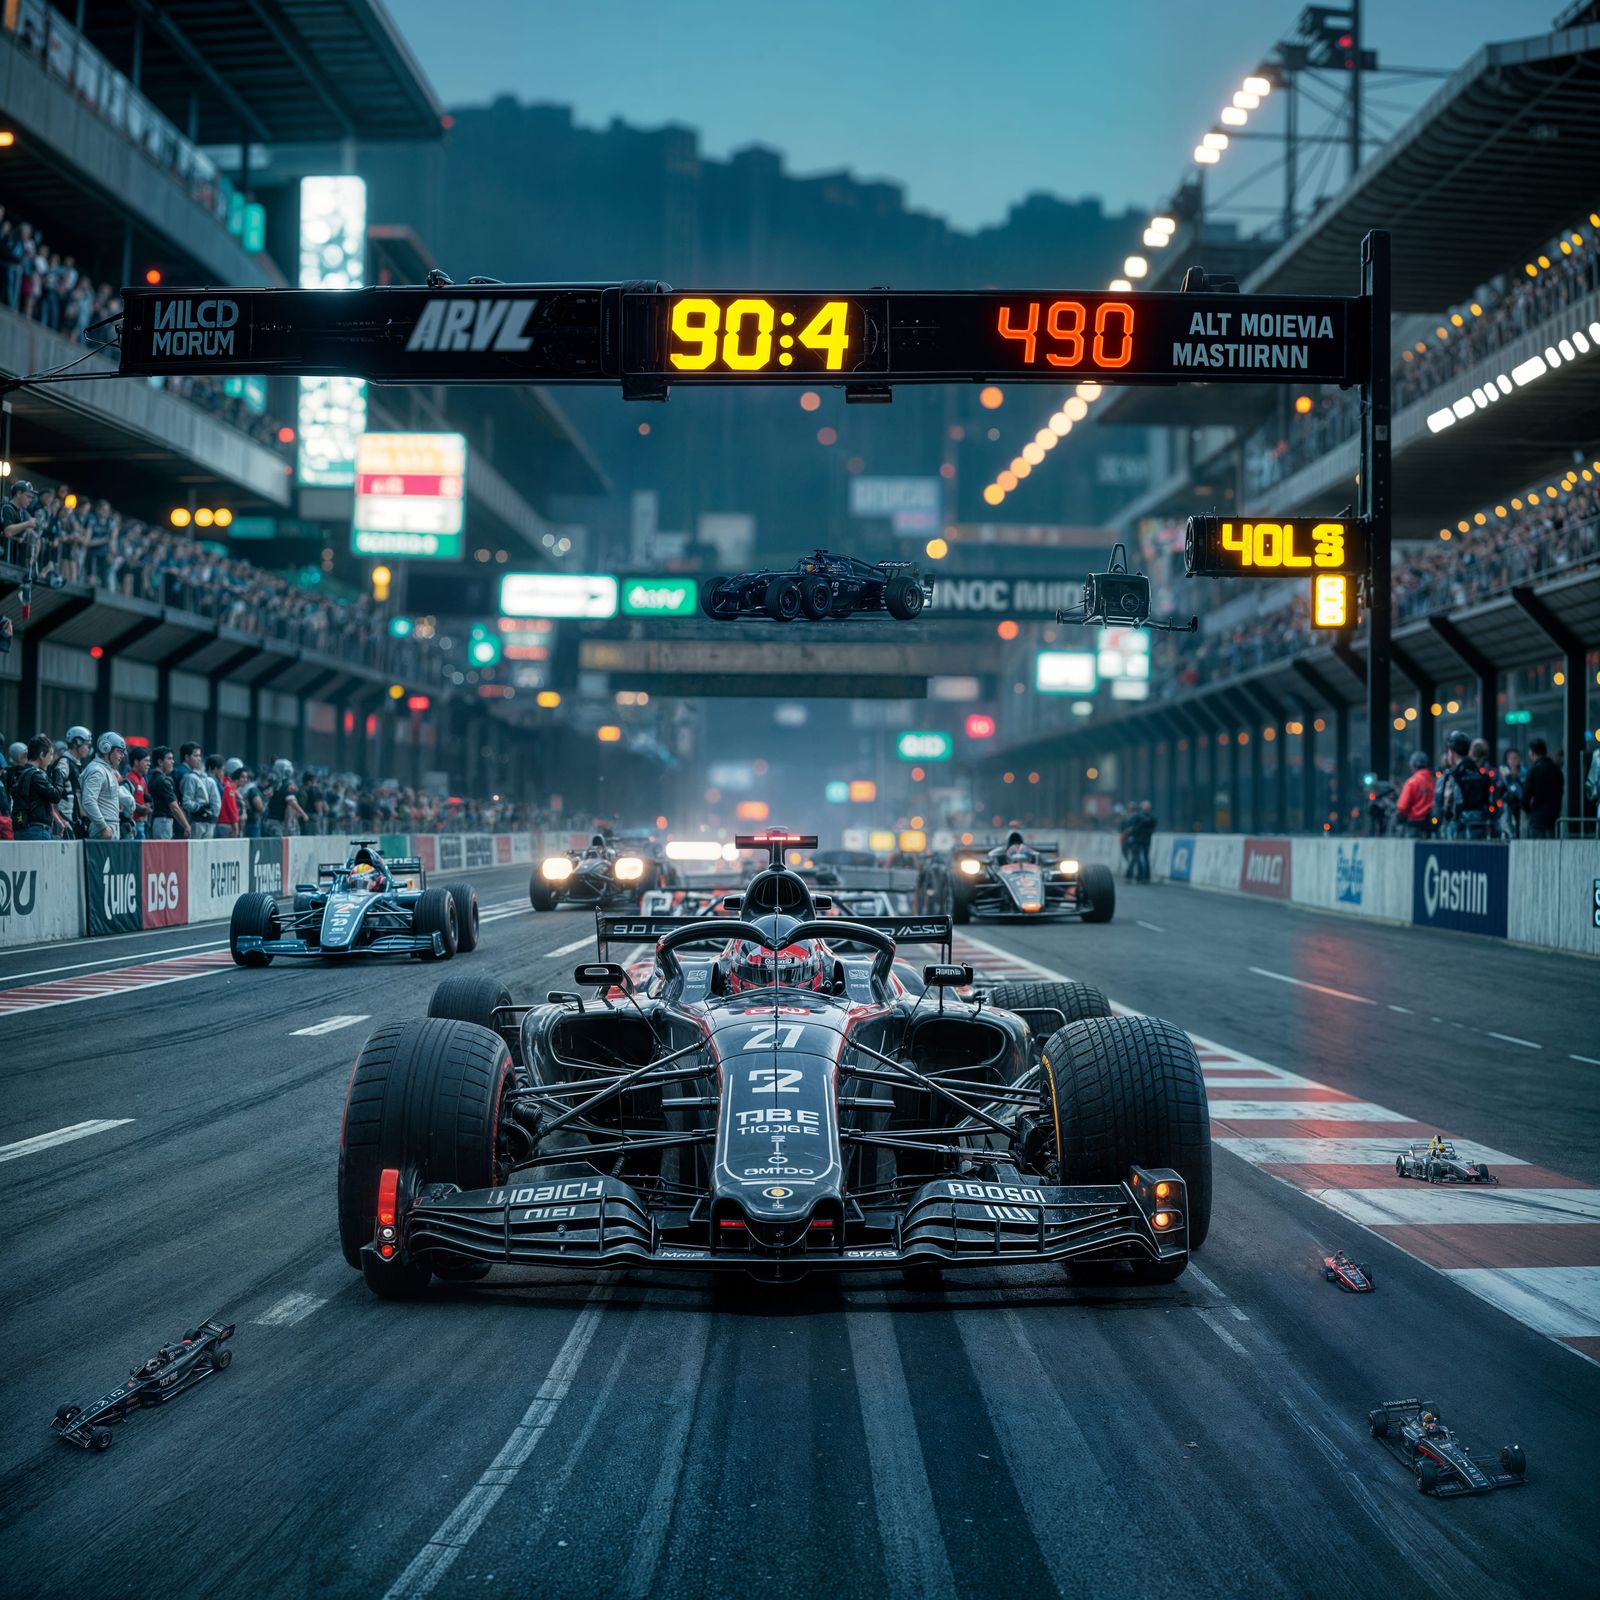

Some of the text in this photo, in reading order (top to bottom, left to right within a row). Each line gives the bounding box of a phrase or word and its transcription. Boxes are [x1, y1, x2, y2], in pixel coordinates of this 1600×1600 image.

[405, 299, 538, 352] ARVL
[997, 301, 1135, 368] 490
[1189, 312, 1232, 336] ALT
[147, 871, 179, 913] DSG
[742, 1024, 806, 1050] 27
